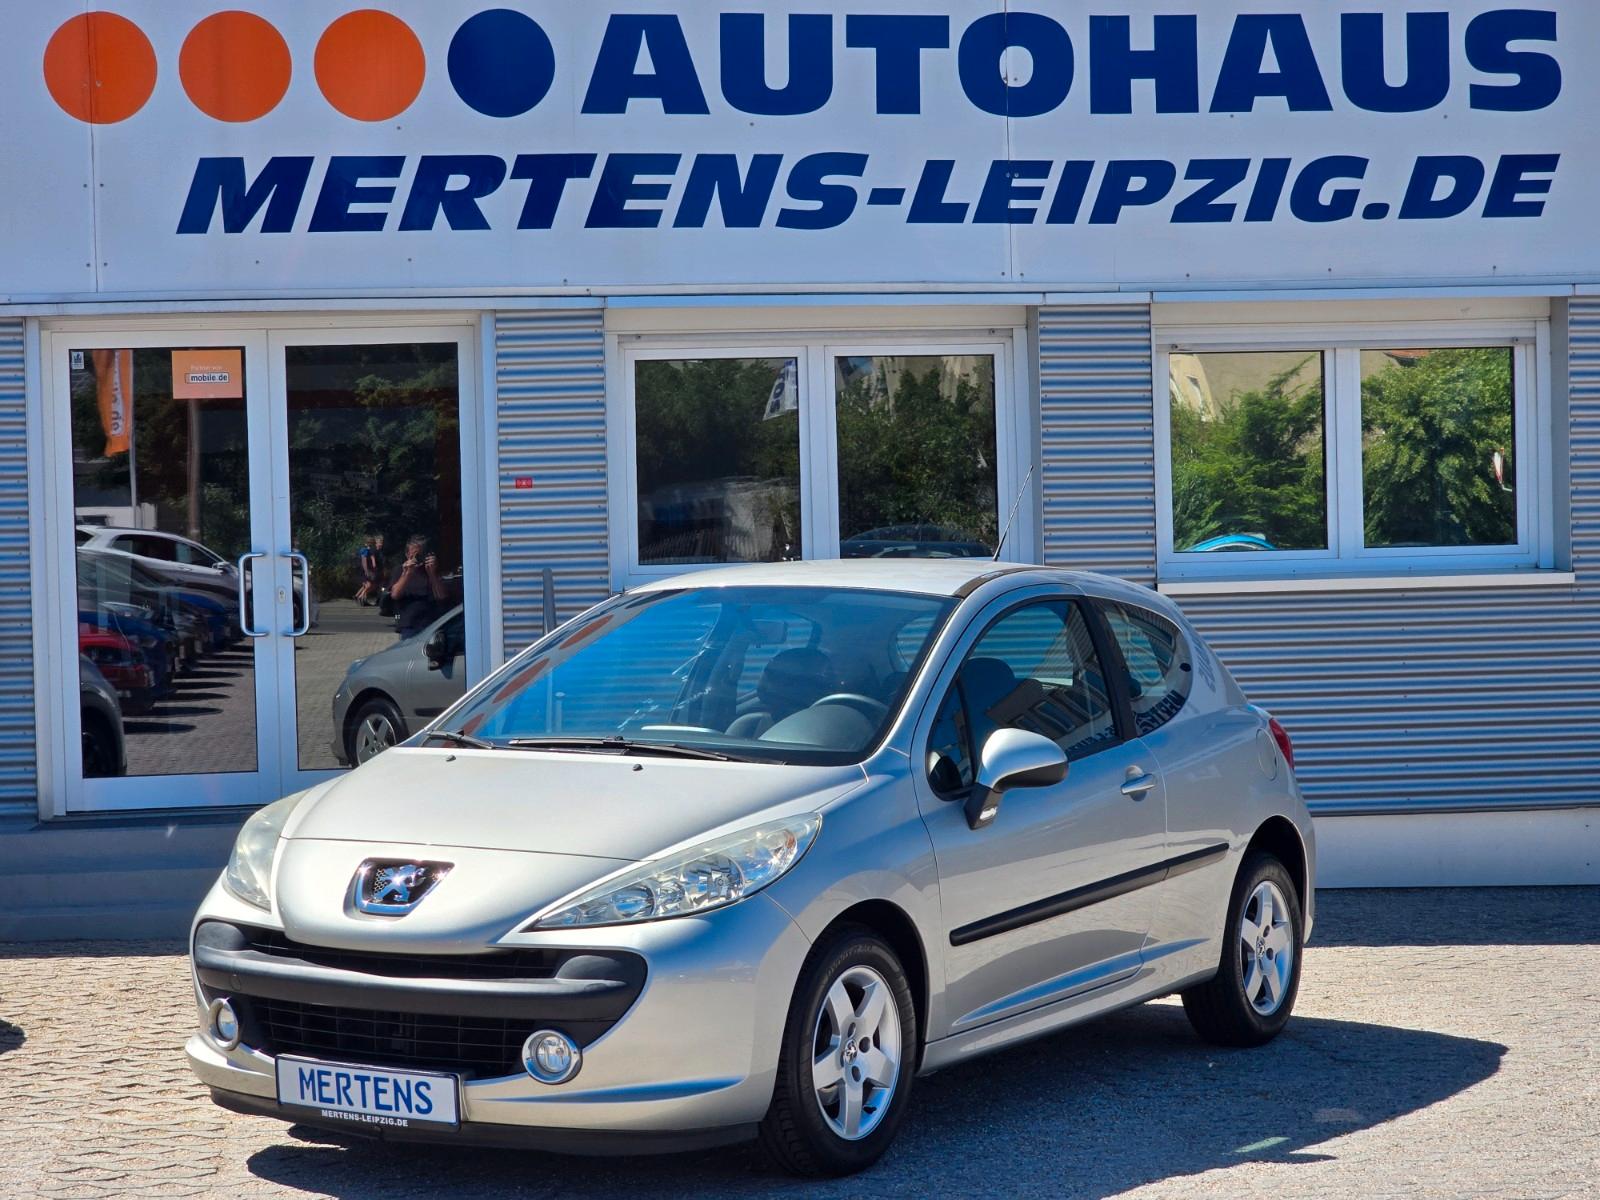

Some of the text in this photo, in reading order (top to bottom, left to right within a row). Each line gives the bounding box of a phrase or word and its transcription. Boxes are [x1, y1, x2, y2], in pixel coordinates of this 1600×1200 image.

[581, 9, 1561, 118] AUTOHAUS
[176, 152, 1560, 234] MERTENS-LEIPZIG.DE
[298, 1067, 433, 1115] MERTENS
[321, 1109, 408, 1127] MERTENS-LEIPZIG.DE
